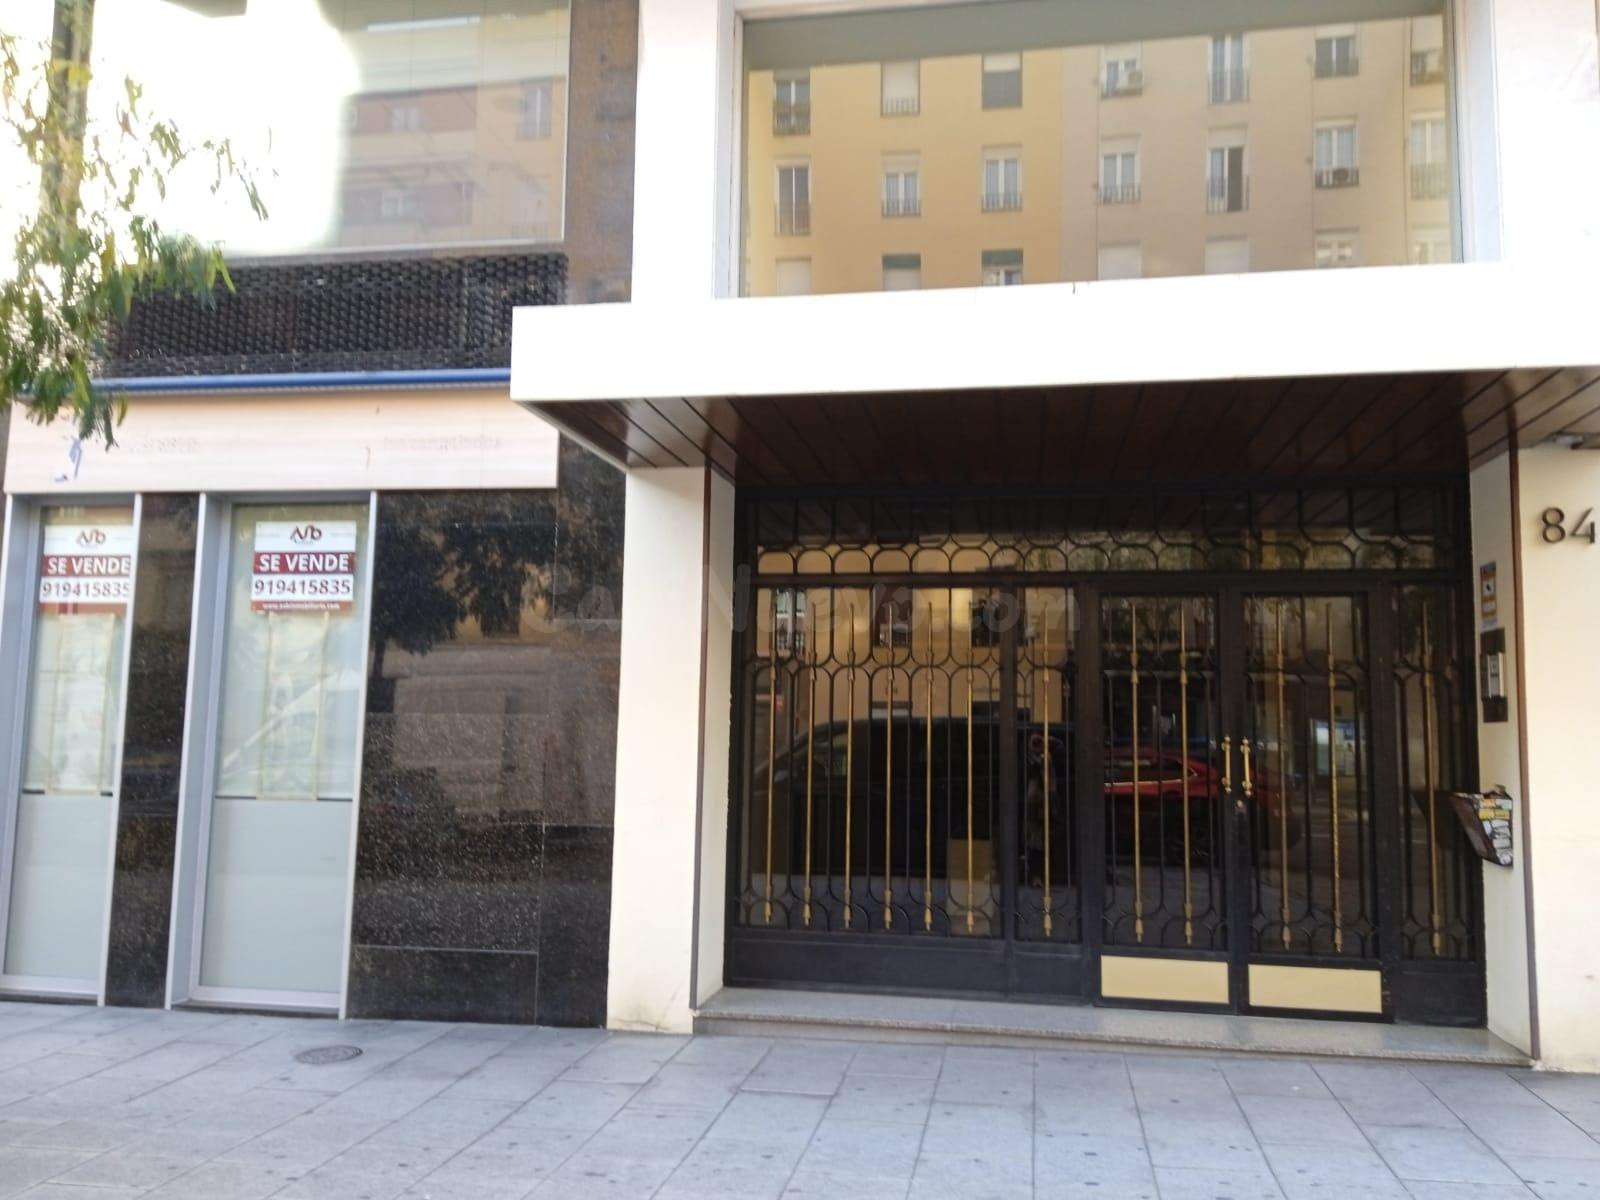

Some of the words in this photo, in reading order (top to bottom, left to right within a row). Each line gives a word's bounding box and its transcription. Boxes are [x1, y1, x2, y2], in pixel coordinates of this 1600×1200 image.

[1541, 506, 1595, 544] 84
[47, 557, 67, 575] SE
[71, 557, 130, 575] VENDE
[259, 554, 280, 571] SE
[285, 554, 349, 571] VENDE
[43, 582, 129, 597] 919415835
[254, 579, 351, 595] 919415835
